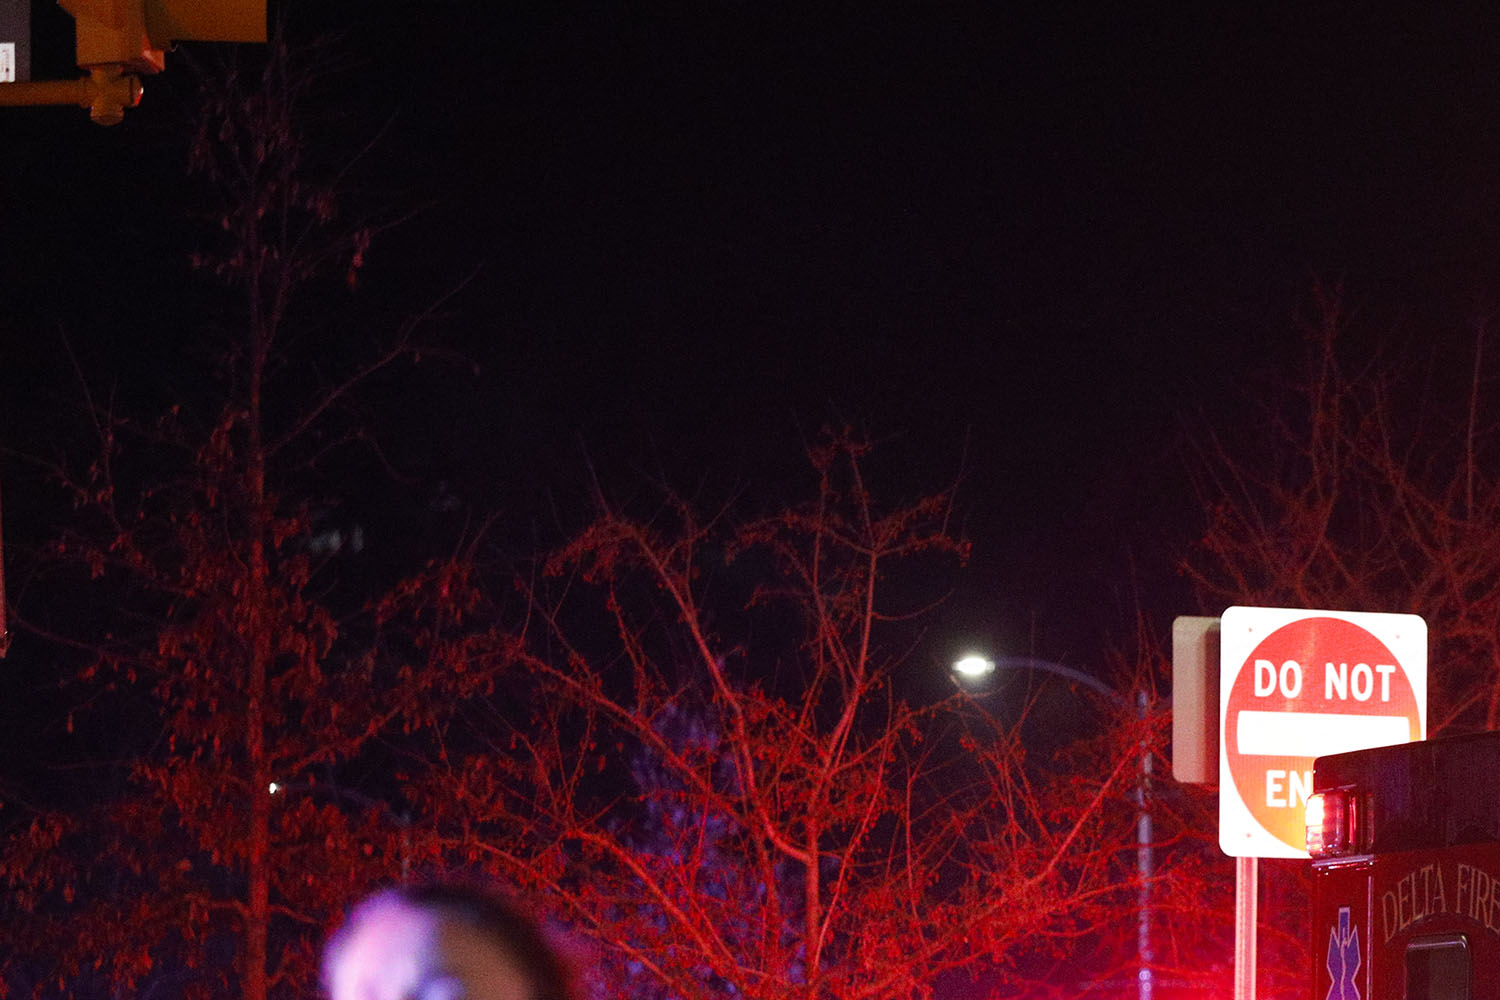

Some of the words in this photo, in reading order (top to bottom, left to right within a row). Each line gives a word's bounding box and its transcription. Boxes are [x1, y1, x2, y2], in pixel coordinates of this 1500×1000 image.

[1254, 659, 1301, 699] DO
[1325, 662, 1396, 702] NOT
[1382, 857, 1447, 945] DELTA
